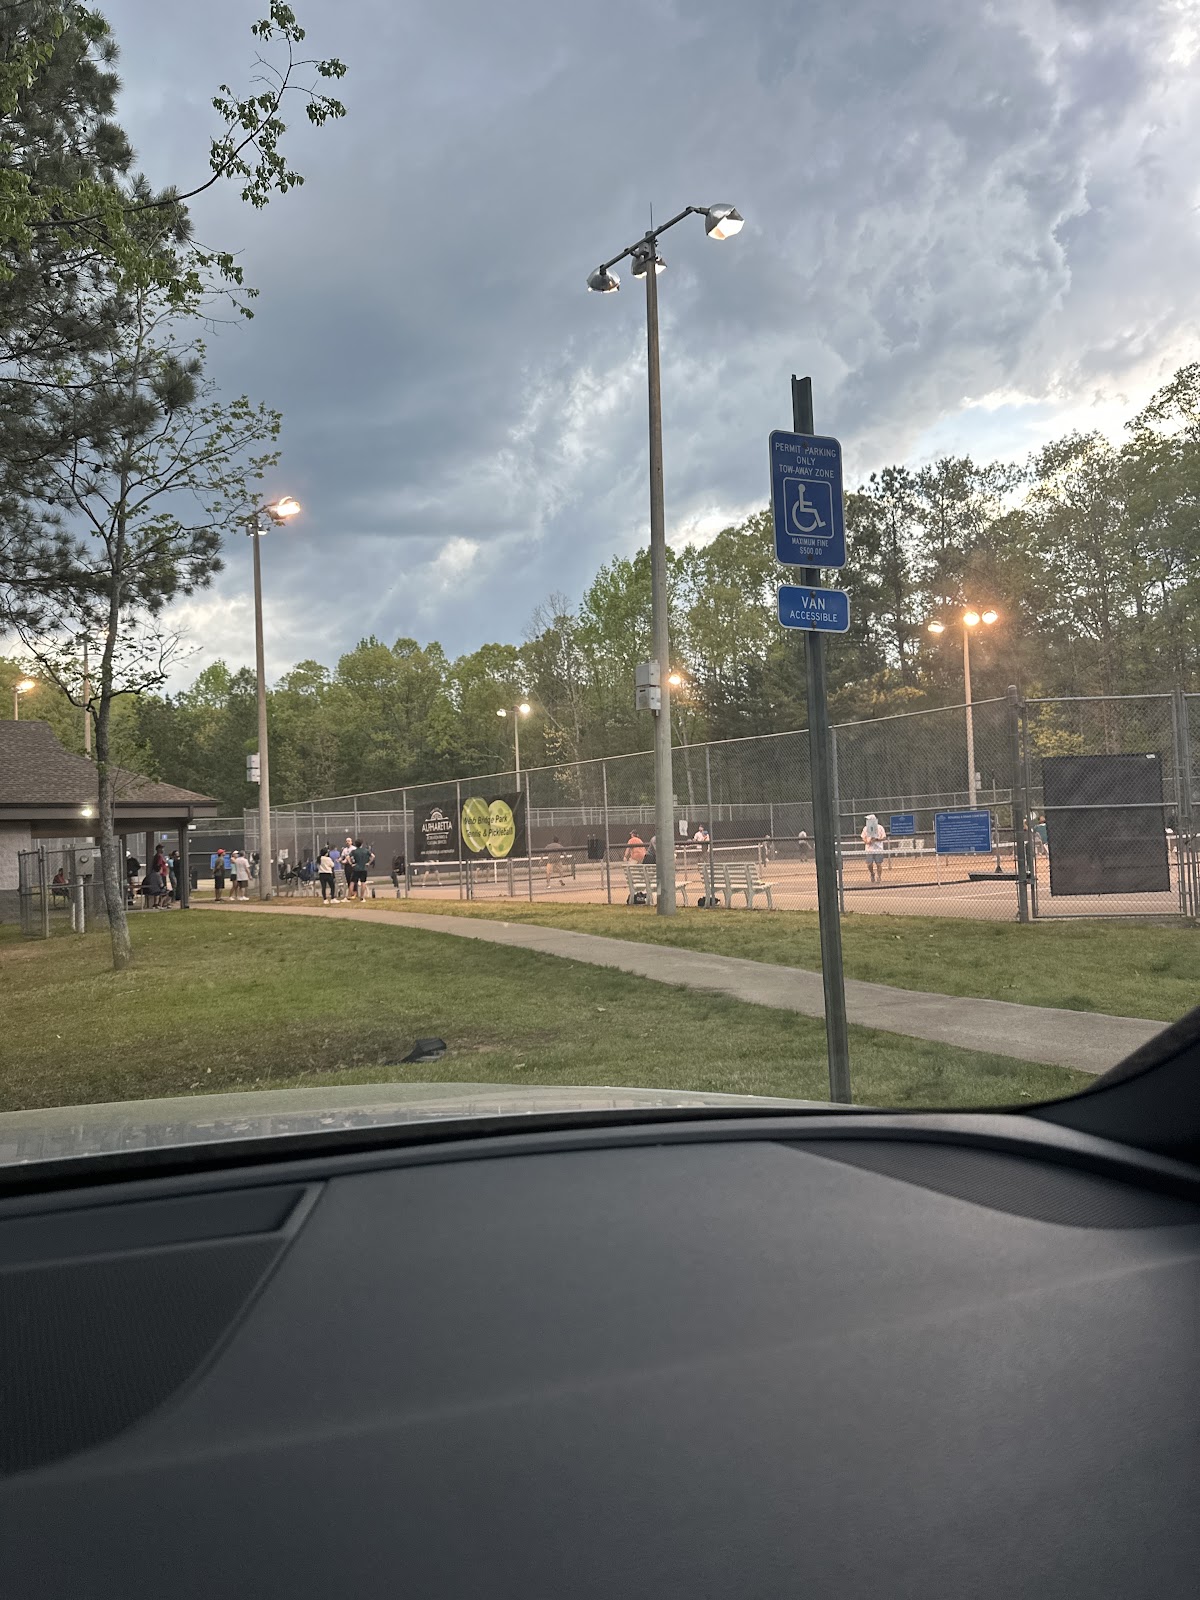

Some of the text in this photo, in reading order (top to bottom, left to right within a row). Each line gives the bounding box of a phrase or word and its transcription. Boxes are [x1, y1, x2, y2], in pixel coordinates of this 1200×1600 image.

[776, 442, 836, 458] PERMIT PARKING
[796, 456, 815, 465] ONLY
[778, 464, 834, 478] TOW-AWAY ZONE
[791, 537, 815, 547] MAXIMUM
[799, 547, 823, 555] $500.00
[801, 596, 825, 610] VAN
[790, 610, 838, 622] ACCESSIBLE
[478, 816, 494, 825] Bridge
[495, 815, 508, 823] Park
[422, 821, 452, 832] ALPHARETTA
[488, 827, 513, 836] Pickleball
